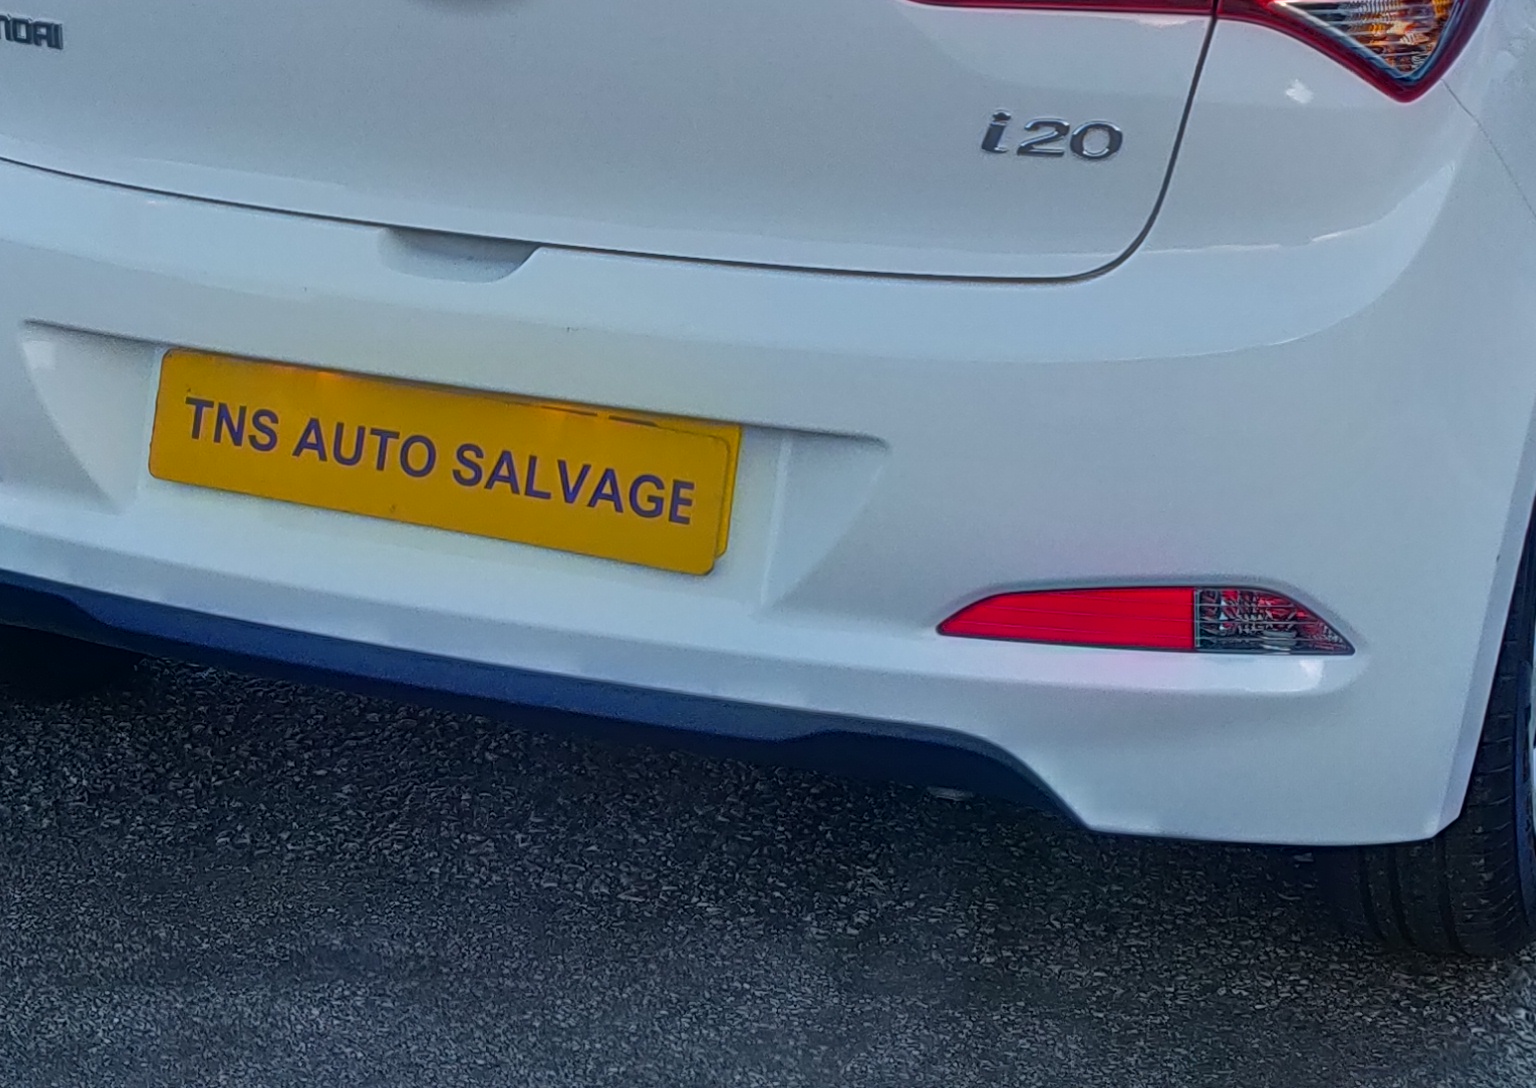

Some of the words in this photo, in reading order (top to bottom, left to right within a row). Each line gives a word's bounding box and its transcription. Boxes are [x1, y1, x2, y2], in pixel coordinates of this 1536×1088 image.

[981, 109, 1123, 159] i20
[185, 396, 277, 452] TNS
[292, 417, 437, 478] AUTO
[452, 443, 696, 525] SALVAGE
